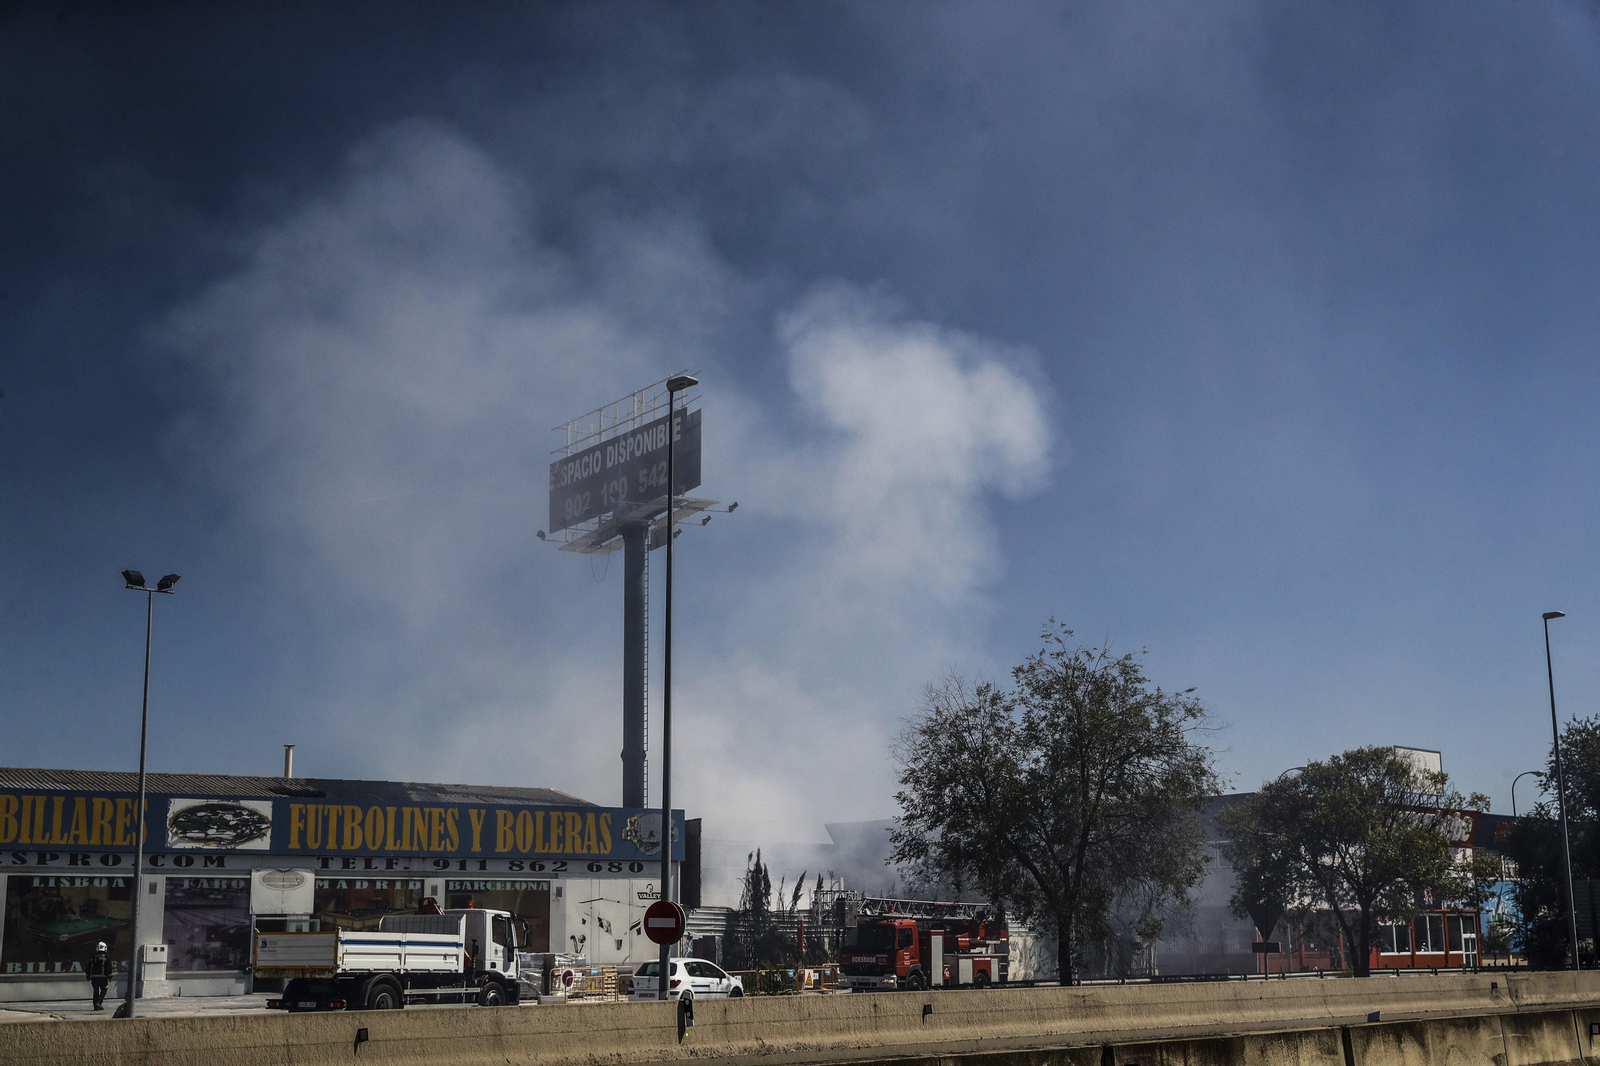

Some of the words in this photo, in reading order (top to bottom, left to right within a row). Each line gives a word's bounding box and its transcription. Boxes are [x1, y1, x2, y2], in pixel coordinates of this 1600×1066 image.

[606, 416, 681, 469] DISPONIBLE
[565, 491, 591, 520] 902
[638, 461, 668, 493] 542
[0, 794, 148, 846] BILLARES
[287, 803, 460, 852] FUTBOLINES
[468, 808, 486, 853] Y
[494, 809, 612, 855] BOLERAS
[316, 857, 410, 870] TELF.
[432, 858, 487, 872] 911
[508, 859, 568, 872] 862
[587, 861, 644, 873] 680
[32, 876, 126, 888] LISBOA
[181, 878, 246, 890] FARO
[315, 879, 422, 890] MADRID
[447, 880, 550, 892] BARCELONA
[5, 961, 130, 974] BILLAES
